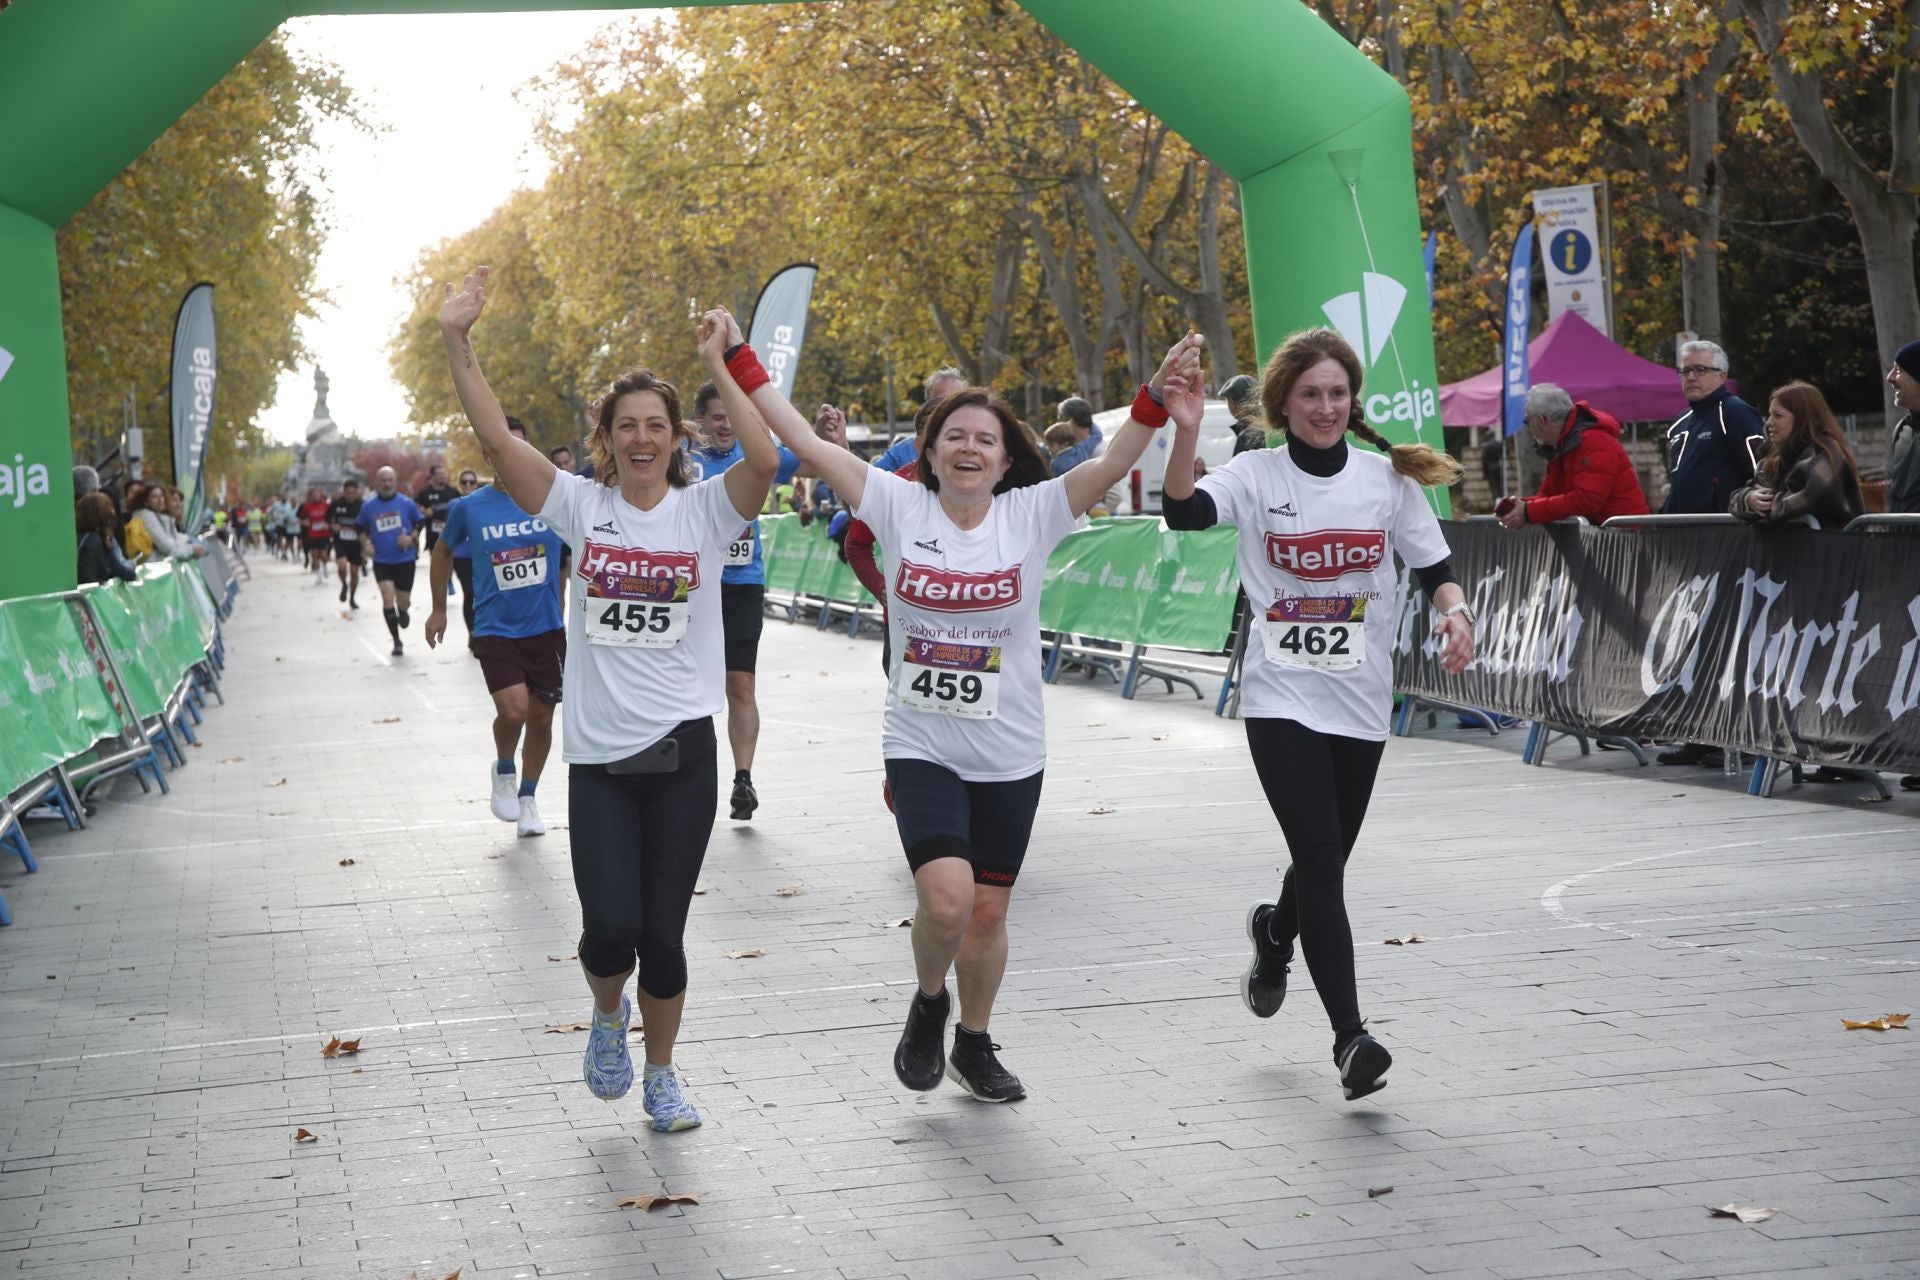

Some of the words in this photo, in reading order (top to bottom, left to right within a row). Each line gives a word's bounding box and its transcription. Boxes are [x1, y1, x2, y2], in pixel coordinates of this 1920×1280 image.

[1366, 380, 1436, 430] caja
[481, 518, 547, 541] IVECO
[502, 560, 539, 581] 601
[583, 547, 692, 583] Helios
[1272, 542, 1381, 570] Helios
[900, 568, 1014, 600] Helios
[600, 602, 670, 634] 455
[947, 627, 967, 639] del
[1279, 625, 1350, 655] 462
[1718, 567, 1882, 718] Norte
[911, 669, 982, 703] 459
